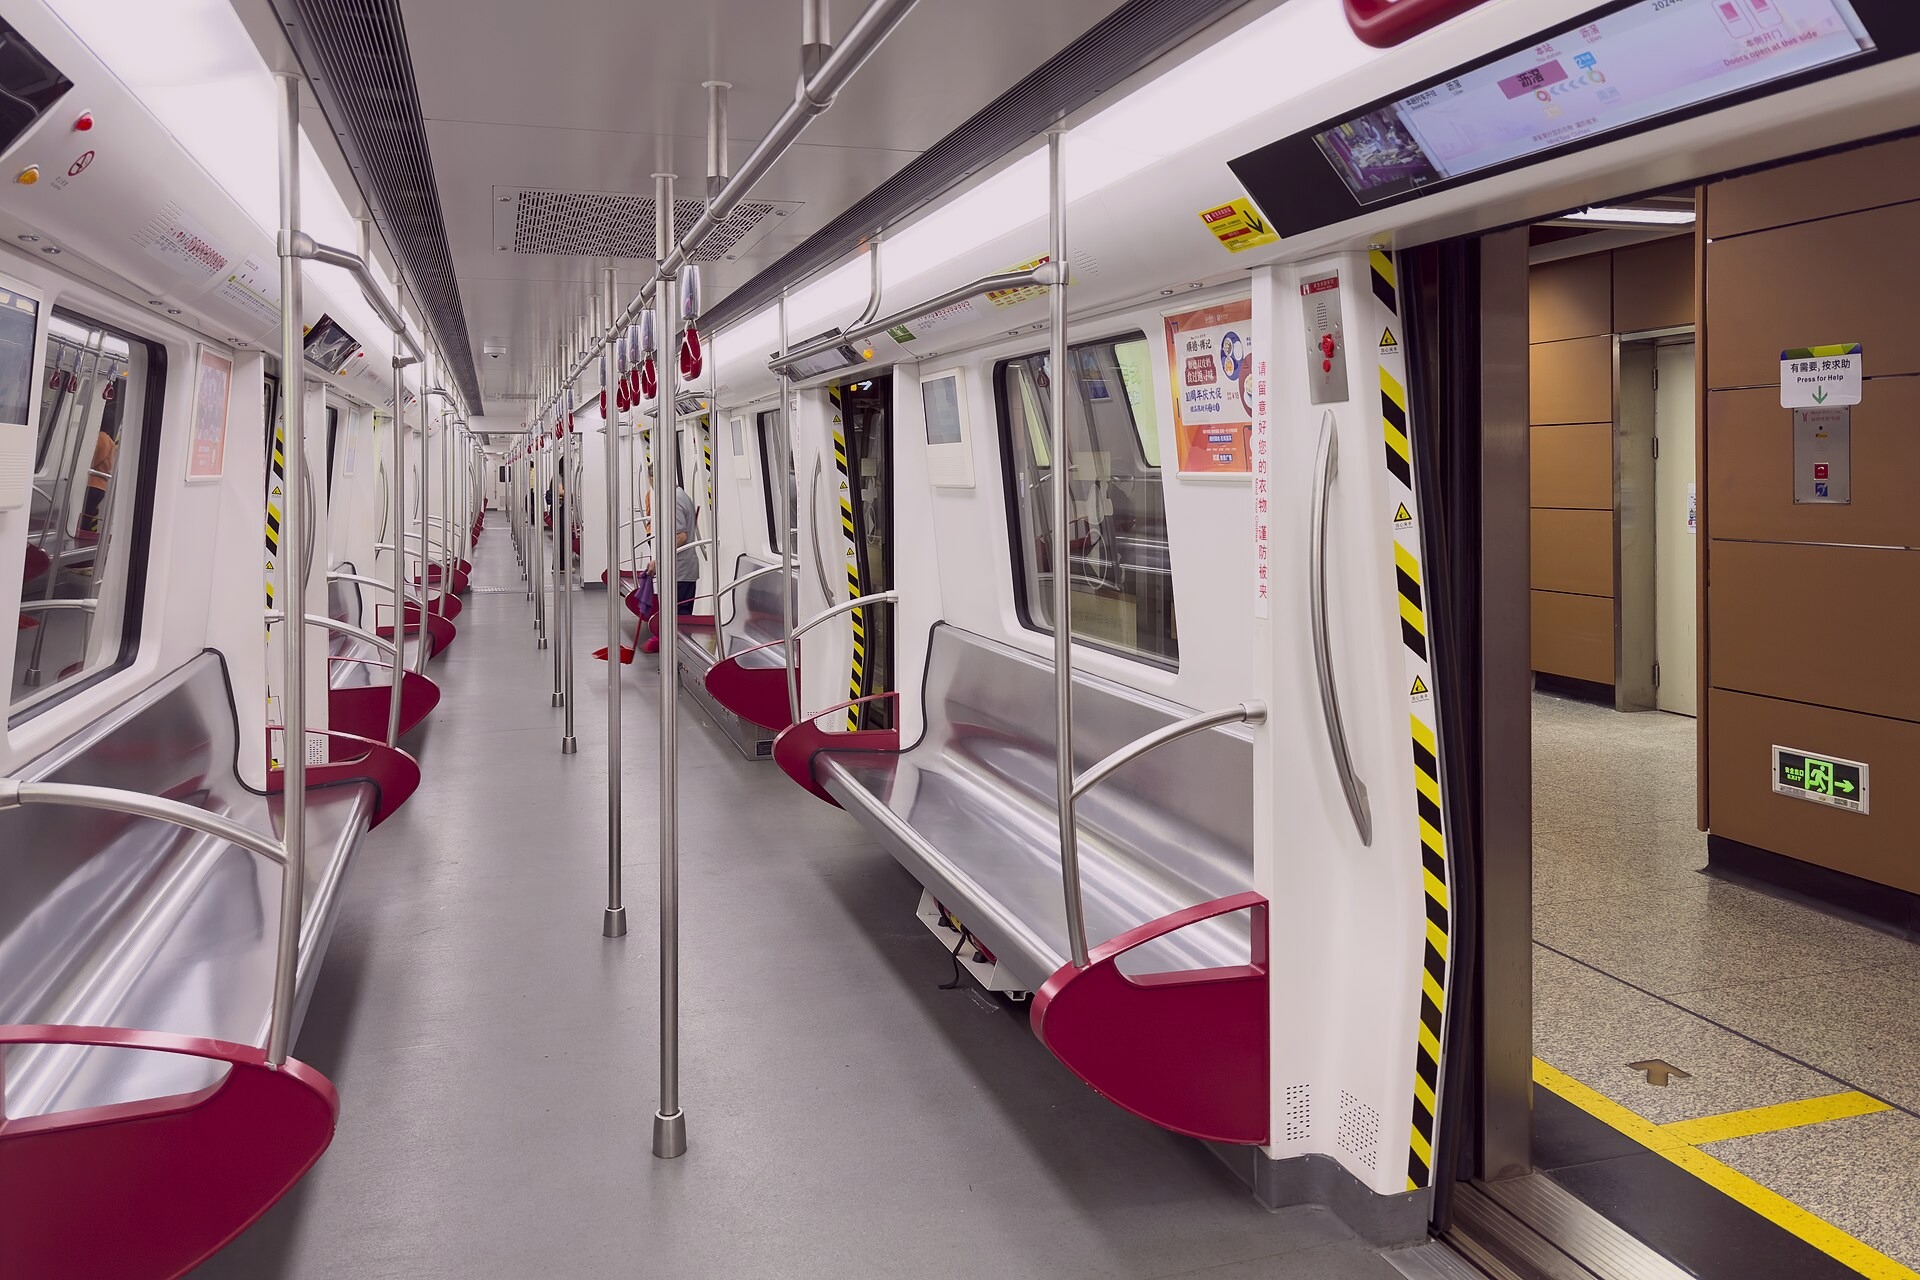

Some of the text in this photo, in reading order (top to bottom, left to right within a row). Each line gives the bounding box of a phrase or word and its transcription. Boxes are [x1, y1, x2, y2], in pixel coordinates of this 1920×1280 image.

[1723, 31, 1818, 67] Doors open at this side
[1827, 374, 1844, 382] Help
[1258, 361, 1268, 599] 请留意好您的衣物 谨防被夹
[1787, 773, 1802, 781] EXIT
